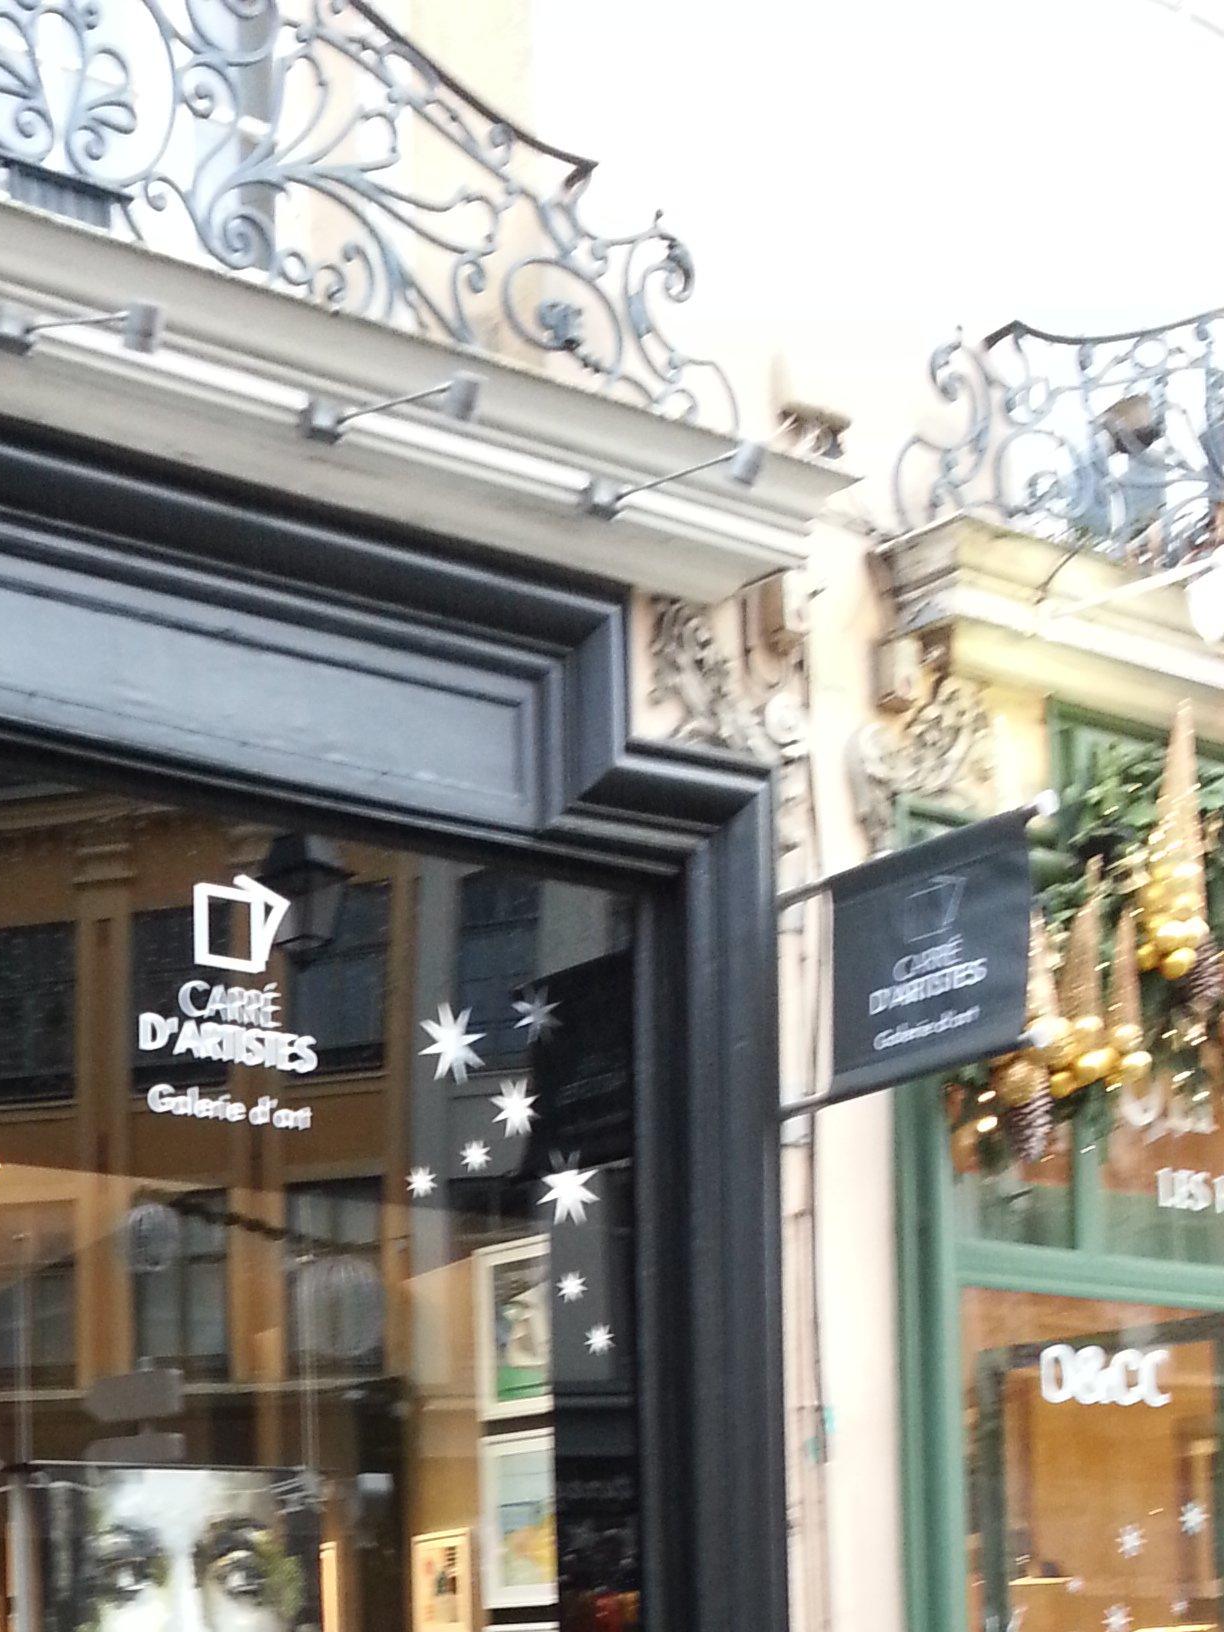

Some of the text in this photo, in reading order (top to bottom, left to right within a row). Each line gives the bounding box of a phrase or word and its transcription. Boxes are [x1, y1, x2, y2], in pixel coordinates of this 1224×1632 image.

[178, 977, 282, 1028] CARRÉ
[138, 1012, 318, 1073] D'ARTISTES
[147, 1083, 313, 1131] Galerie d'art
